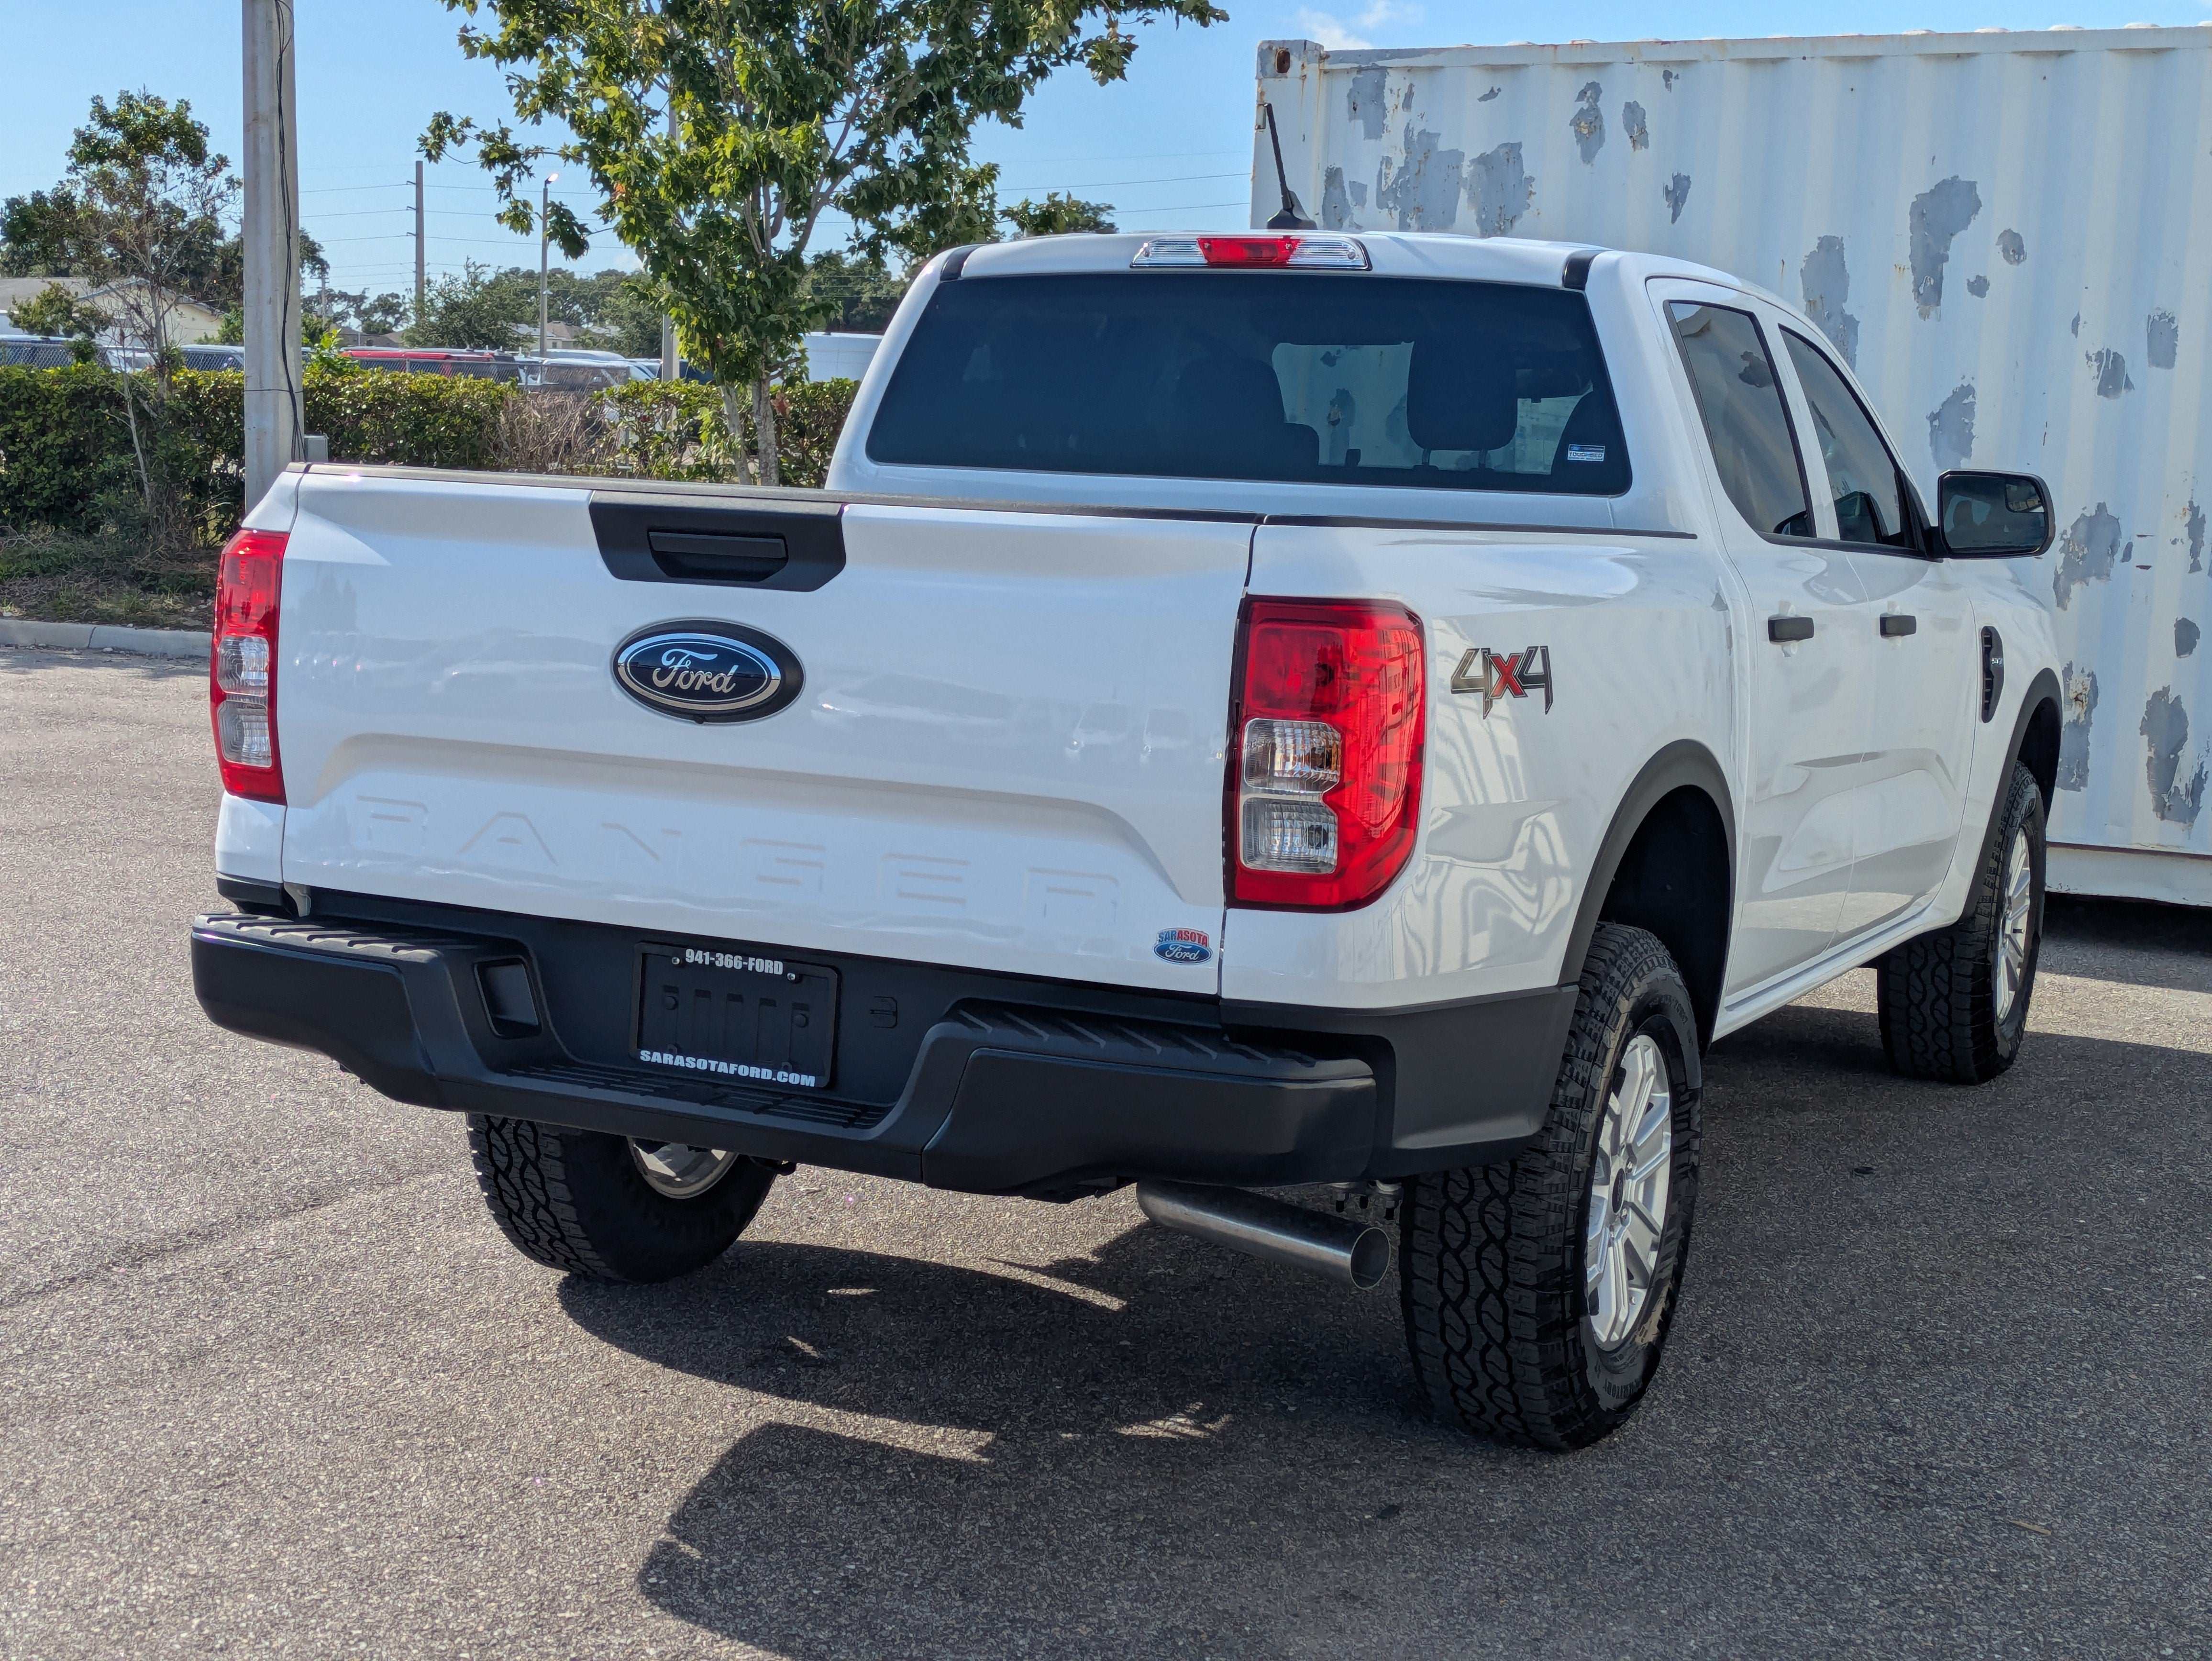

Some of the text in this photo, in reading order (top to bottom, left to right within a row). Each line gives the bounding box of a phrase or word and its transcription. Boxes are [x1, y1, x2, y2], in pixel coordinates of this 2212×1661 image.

[652, 648, 736, 693] Ford
[352, 794, 1120, 924] RANGER
[1158, 930, 1208, 948] SARASOTA
[1165, 944, 1200, 961] Ford
[685, 949, 783, 975] 941-366-FORD
[640, 1050, 816, 1087] SARASOTAFORD.COM
